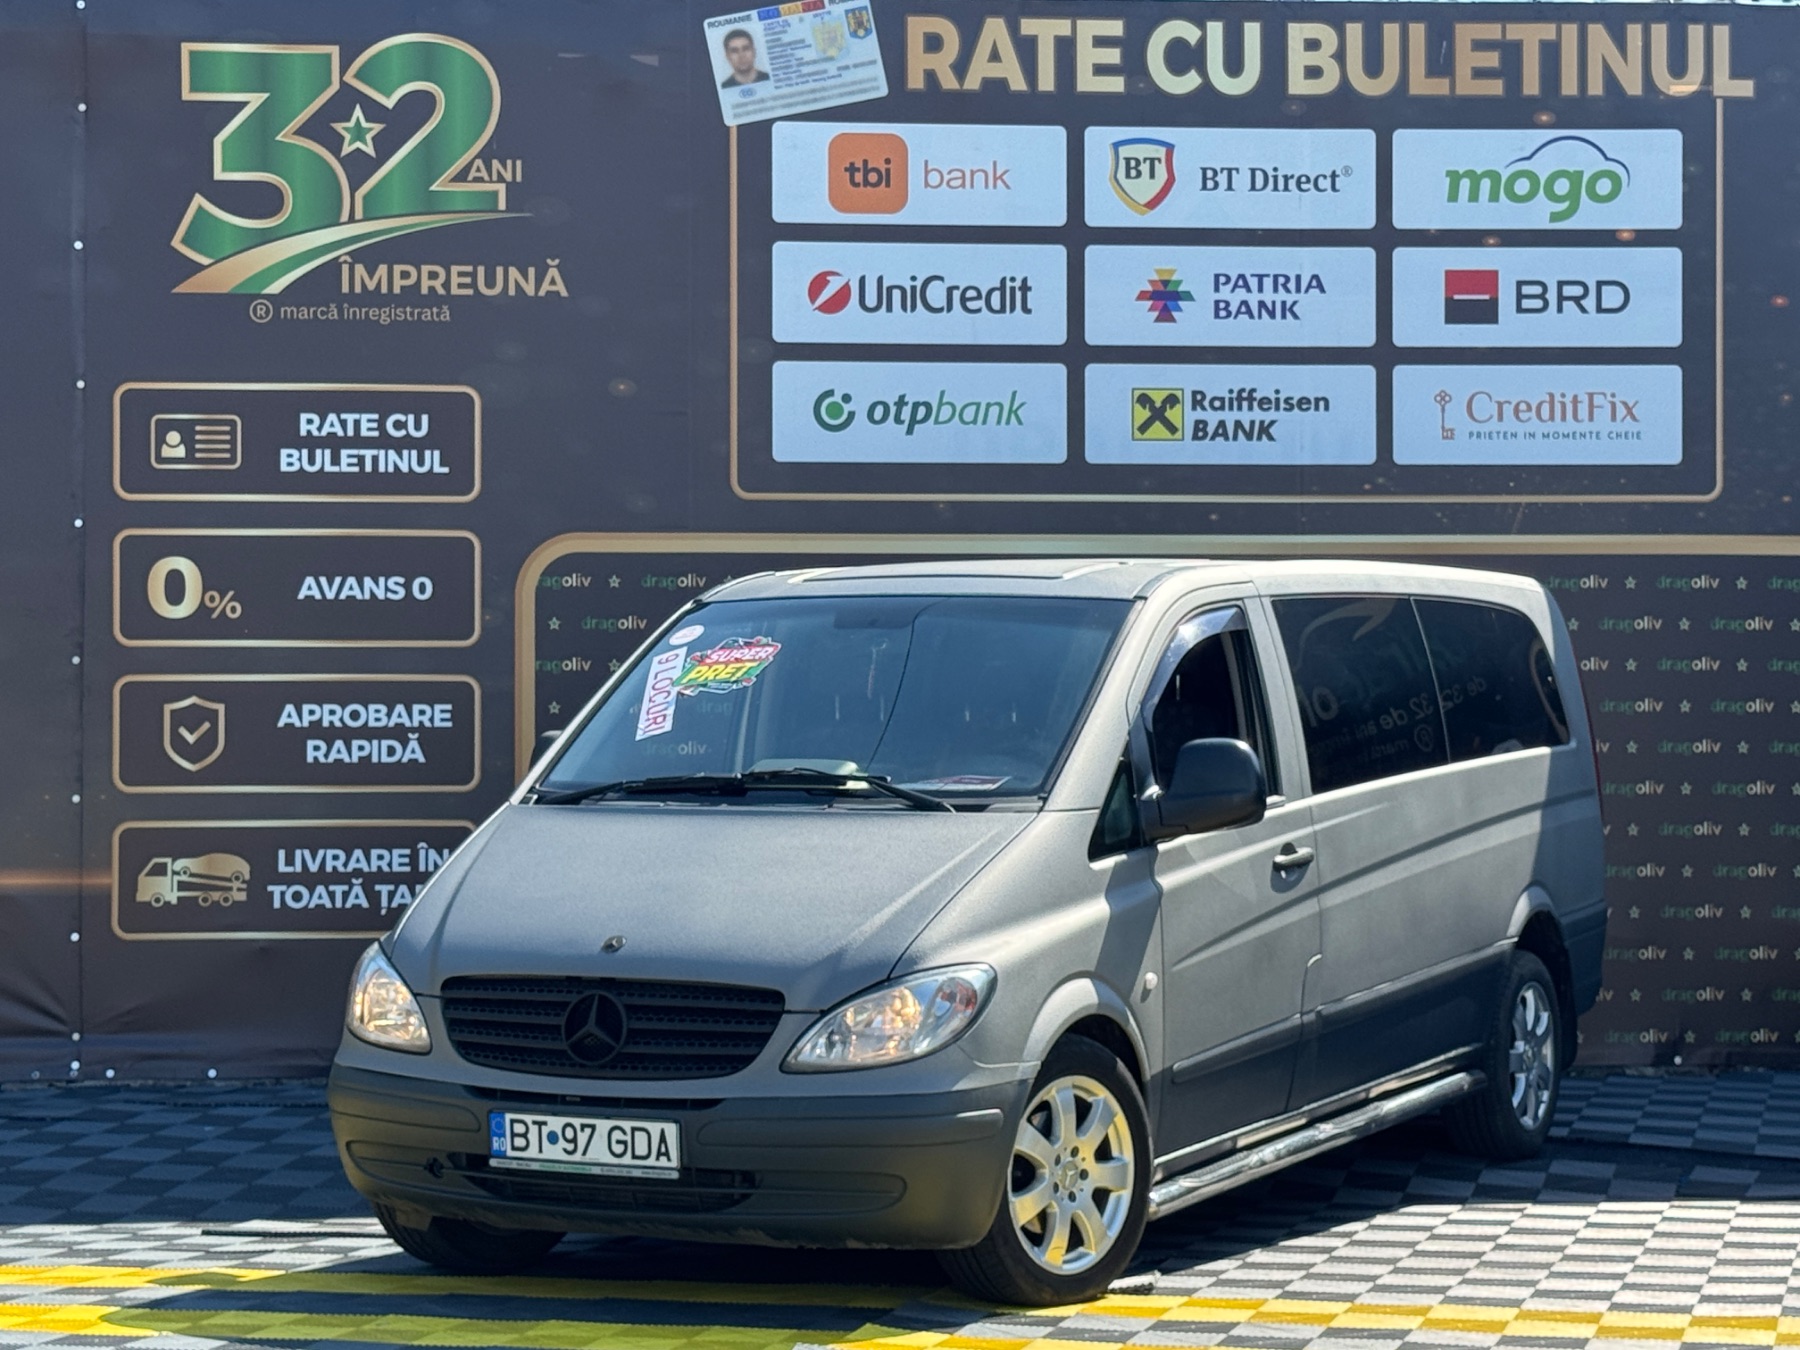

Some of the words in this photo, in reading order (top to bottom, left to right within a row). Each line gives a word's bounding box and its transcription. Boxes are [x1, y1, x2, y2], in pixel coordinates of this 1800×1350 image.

[906, 16, 1125, 94] RATE
[1146, 19, 1262, 95] CU
[1287, 22, 1754, 98] BULETINUL
[170, 32, 507, 267] 32
[467, 159, 523, 183] ANI
[844, 157, 892, 188] tbi
[923, 159, 1012, 190] bank
[1123, 157, 1162, 180] BT
[1200, 166, 1240, 192] BT
[1445, 168, 1623, 223] mogo
[338, 255, 569, 298] ÎMPREUNĂ
[1213, 273, 1327, 294] PATRIA
[858, 274, 1033, 315] UniCredit
[1515, 280, 1631, 314] BRD
[280, 304, 339, 321] marcă
[343, 302, 451, 325] înregistrată
[1213, 299, 1301, 321] BANK
[1190, 387, 1330, 413] Raiffeisen
[1465, 390, 1640, 424] CreditFix
[866, 389, 1028, 436] otpbank
[299, 412, 380, 438] RATE
[385, 413, 430, 439] CU
[1190, 419, 1278, 442] BANK
[1468, 430, 1518, 441] PRIETEN
[1524, 430, 1536, 441] IN
[1542, 430, 1601, 441] MOMENTE
[1607, 431, 1642, 441] CHEIE
[279, 448, 450, 474] BULETINUL
[297, 575, 406, 601] AVANS
[411, 576, 434, 601] 0
[641, 573, 707, 590] dragoliv
[1656, 575, 1720, 592] dragoliv
[582, 615, 648, 633] dragoliv
[1599, 615, 1663, 633] dragoliv
[1711, 616, 1774, 633] dragoliv
[1657, 656, 1721, 674] dragoliv
[640, 666, 677, 736] LOCURI
[1601, 697, 1664, 715] dragoliv
[1711, 698, 1774, 715] dragoliv
[277, 703, 453, 728] APROBARE
[306, 733, 426, 764] RAPIDĂ
[1658, 738, 1721, 756] dragoliv
[1711, 780, 1775, 798] dragoliv
[1658, 821, 1722, 838] dragoliv
[278, 848, 411, 873] LIVRARE
[1713, 863, 1777, 880] dragoliv
[267, 878, 369, 910] TOATĂ
[1660, 904, 1723, 921] dragoliv
[1714, 945, 1778, 962] dragoliv
[1661, 987, 1725, 1004] dragoliv
[1605, 1028, 1668, 1045] dragoliv
[1716, 1028, 1779, 1045] dragoliv
[492, 1136, 506, 1151] RO
[509, 1118, 548, 1154] BT
[561, 1122, 597, 1156] 97
[607, 1125, 672, 1162] GDA
